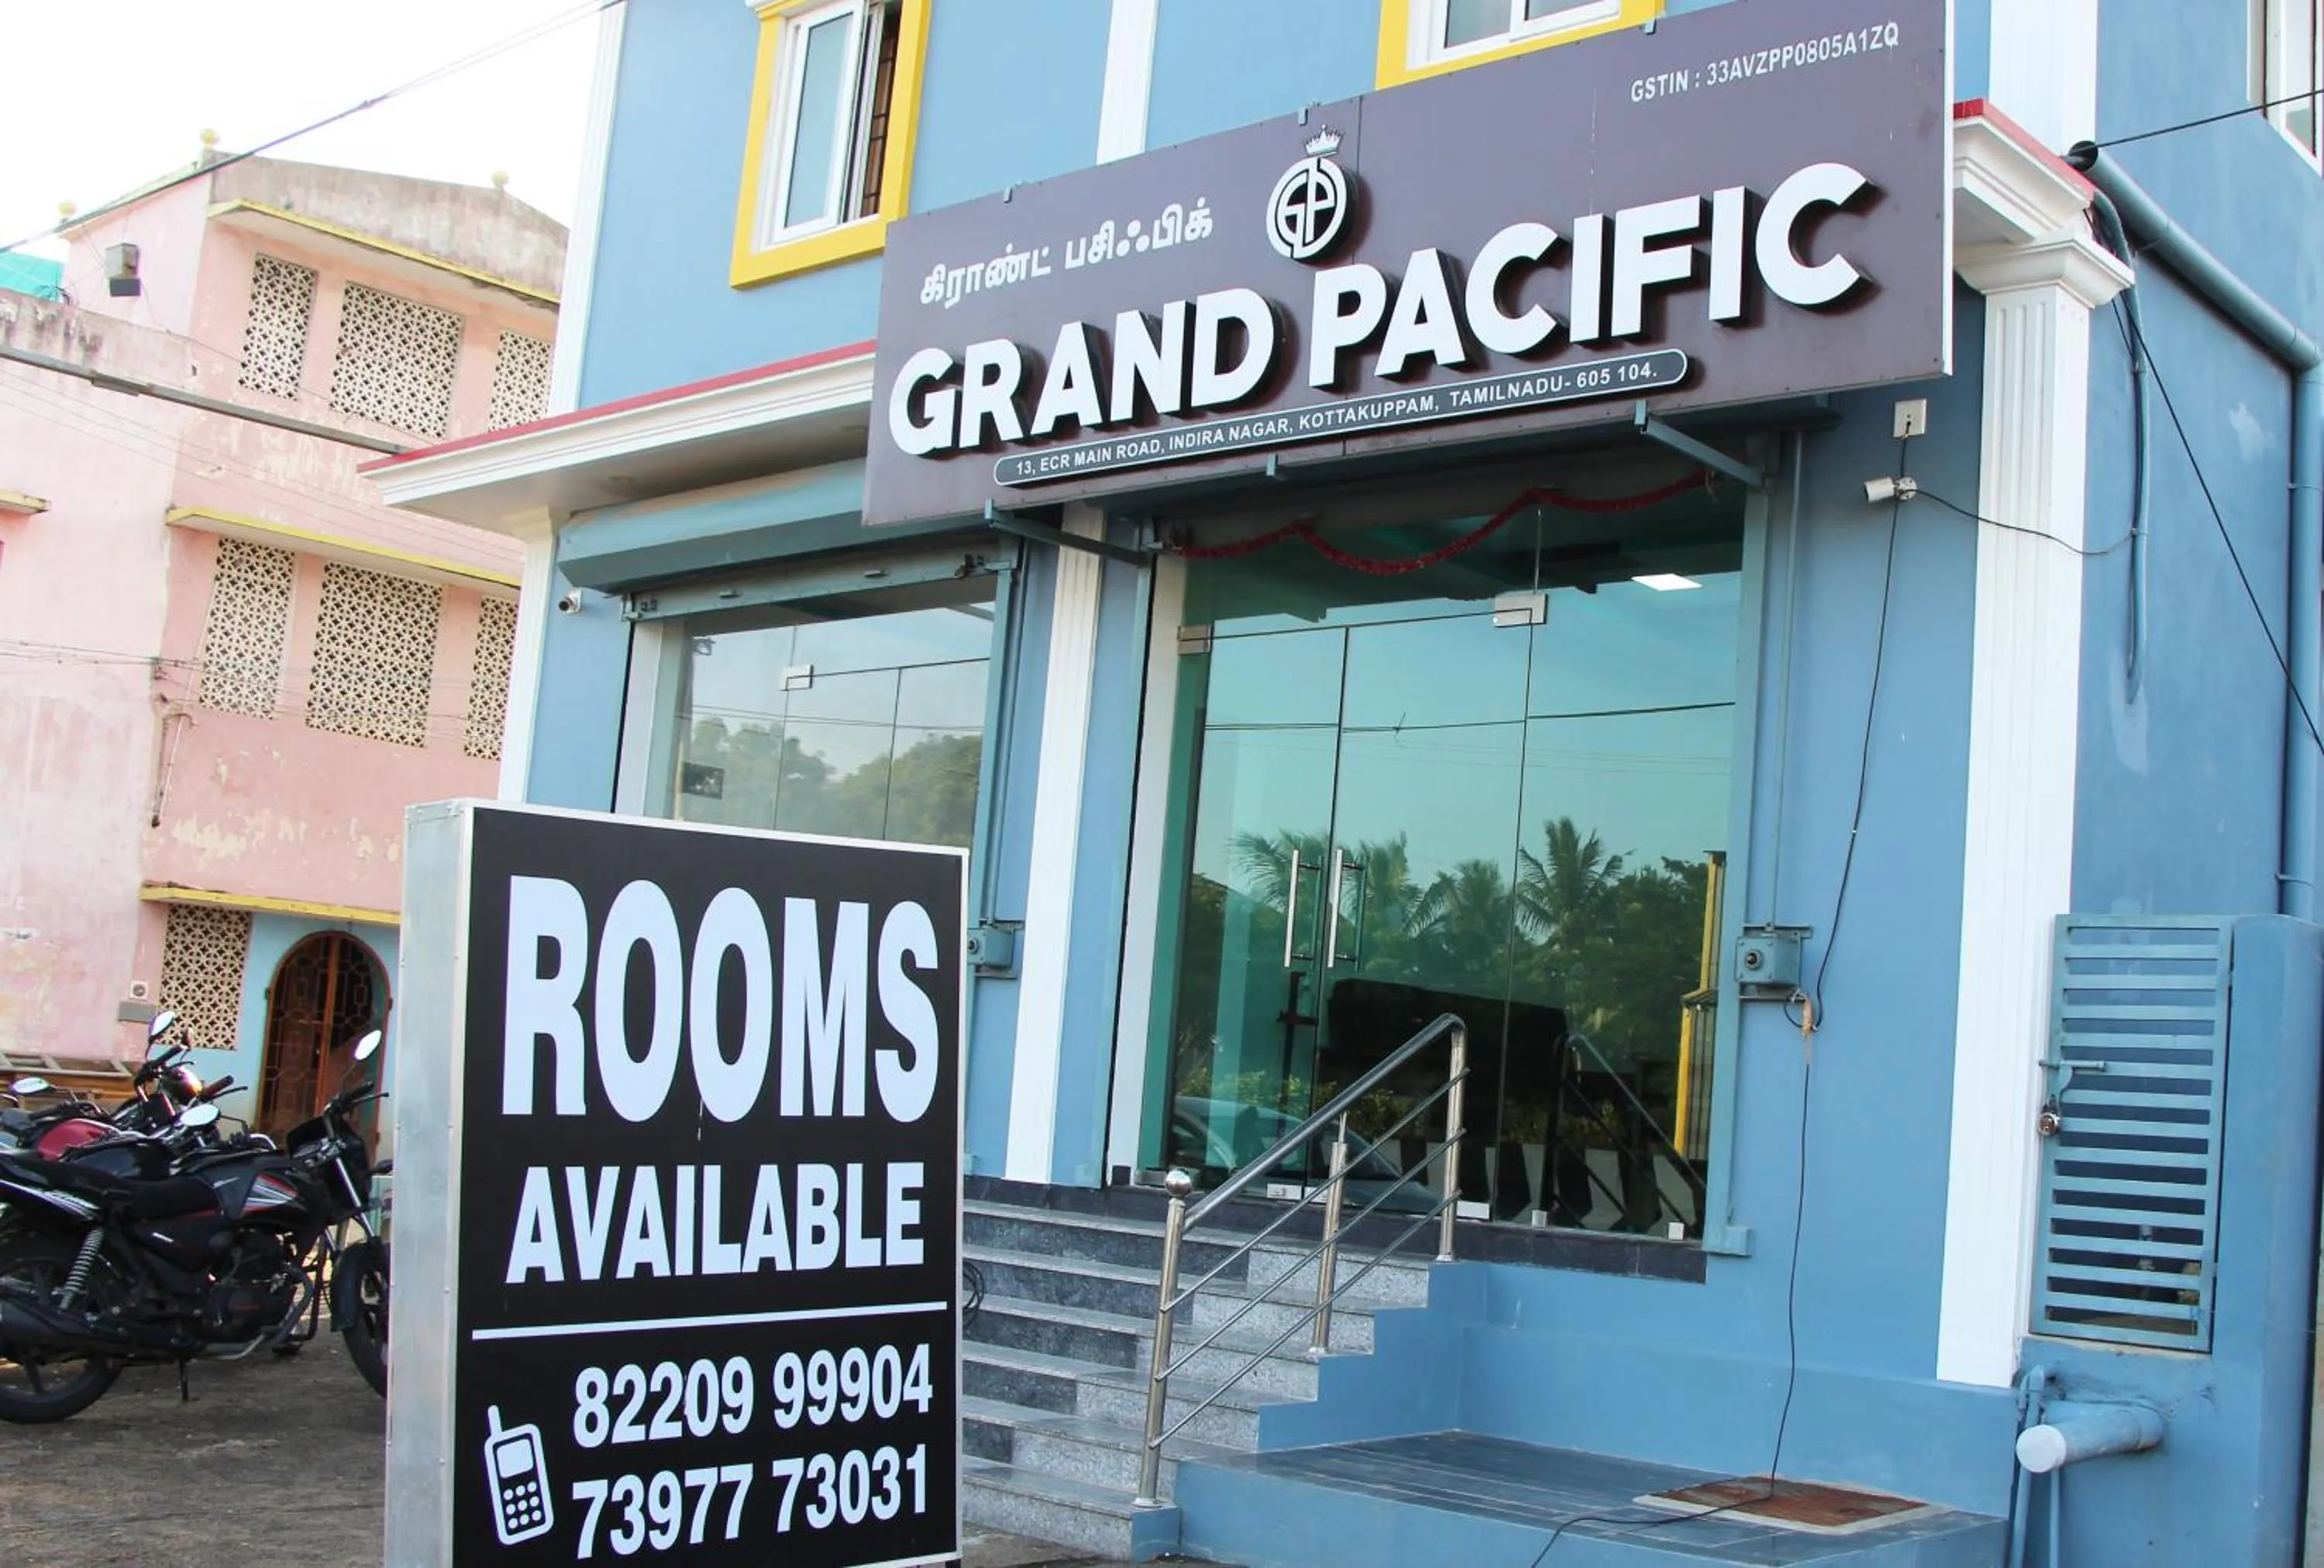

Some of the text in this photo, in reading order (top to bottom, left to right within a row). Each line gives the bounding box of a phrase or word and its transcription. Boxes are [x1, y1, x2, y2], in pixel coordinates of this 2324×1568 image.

[1631, 70, 1689, 102] GSTIN
[1707, 22, 1899, 85] 33AVZPP0805A1ZQ
[889, 163, 1867, 457] GRAND PACIFIC
[920, 242, 1051, 308] கிராண்ட்
[1016, 460, 1036, 475] 13,
[1040, 456, 1070, 471] ECR
[1074, 447, 1112, 466] MAIN
[1116, 439, 1164, 459] ROAD,
[1169, 428, 1224, 449] INDIRA
[1229, 418, 1293, 442] NAGAR,
[1299, 395, 1439, 430] KOTTAKUPPAM,
[1576, 368, 1611, 387] 605
[1618, 361, 1657, 381] 104.
[502, 875, 939, 1123] ROOMS
[505, 1161, 925, 1284] AVAILABLE
[573, 1343, 933, 1449] 82209 99904
[572, 1443, 927, 1560] 73977 73031
